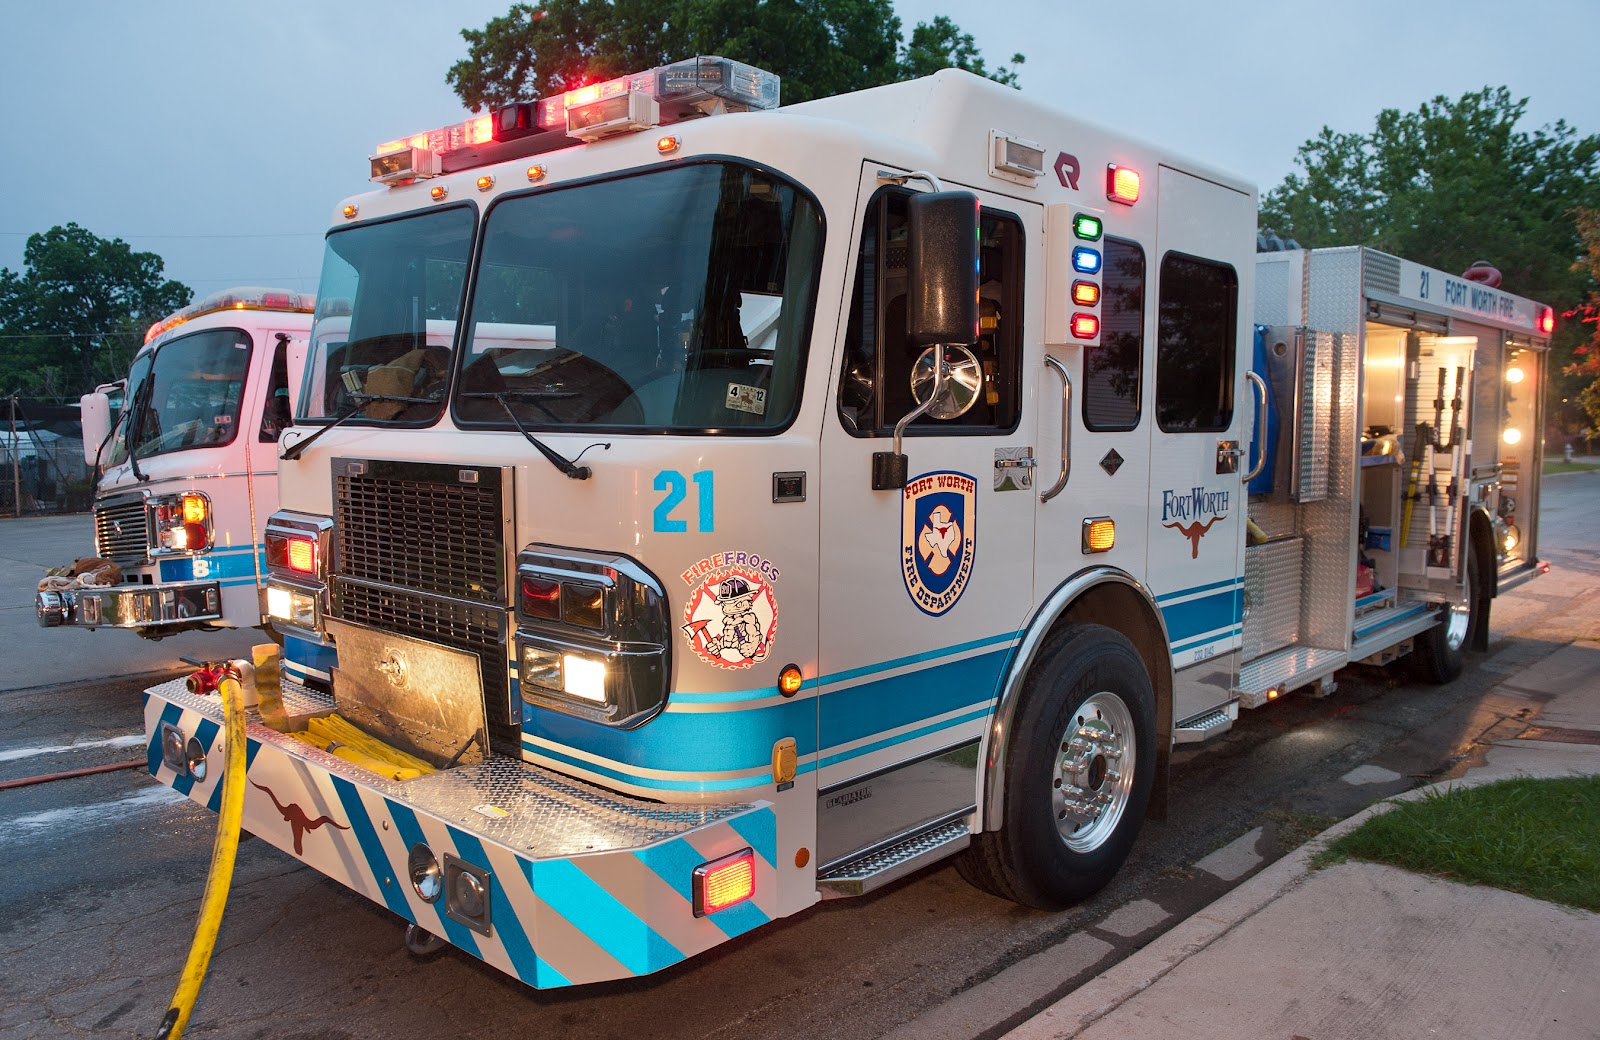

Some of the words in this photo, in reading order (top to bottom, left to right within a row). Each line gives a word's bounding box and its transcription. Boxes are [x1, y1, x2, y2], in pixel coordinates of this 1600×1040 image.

[1420, 270, 1430, 299] 21
[1445, 279, 1467, 306] FORT
[1471, 287, 1497, 314] WORTH
[1499, 296, 1515, 318] FIRE
[730, 386, 738, 397] 4
[756, 391, 764, 402] 12
[904, 477, 933, 500] FORT
[937, 475, 974, 494] WORTH
[653, 470, 714, 532] 21
[193, 560, 210, 578] 8
[905, 545, 919, 588] FIRE
[916, 538, 973, 610] DEPARTMENT
[826, 786, 872, 809] GLADIATOR
